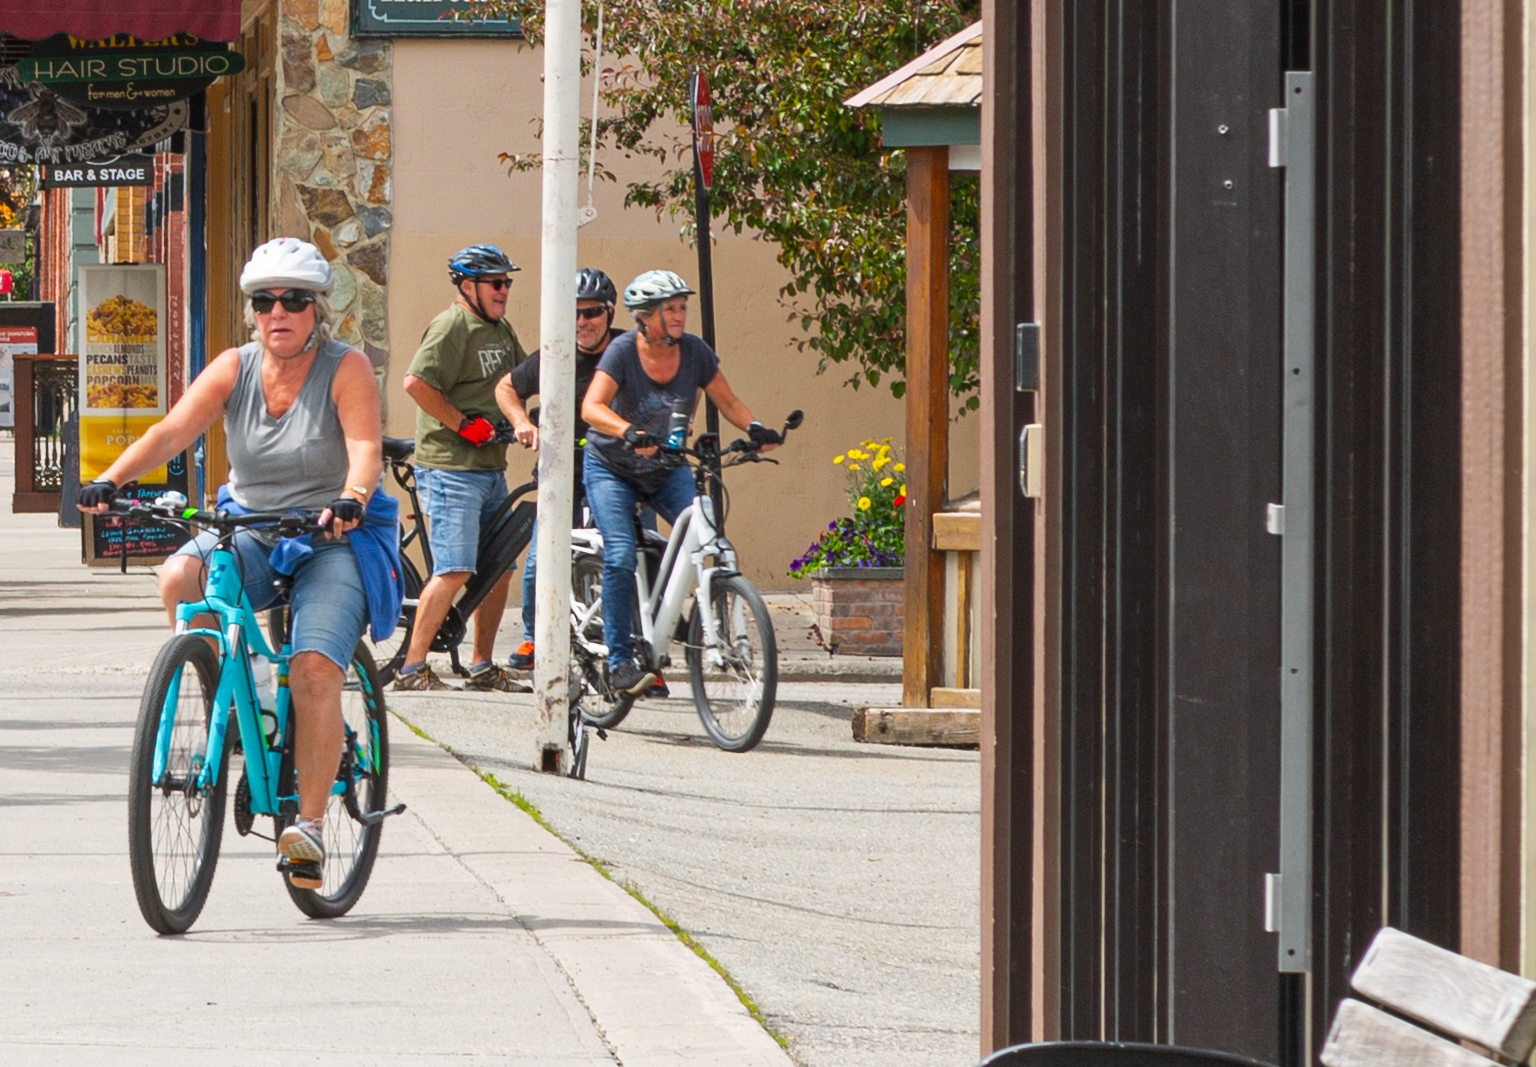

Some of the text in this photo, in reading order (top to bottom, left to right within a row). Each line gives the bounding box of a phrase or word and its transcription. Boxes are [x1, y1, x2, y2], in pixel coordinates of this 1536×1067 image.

[34, 55, 230, 80] HAIR STUDIO
[88, 83, 106, 101] for
[106, 90, 125, 100] men
[143, 88, 176, 98] women
[53, 168, 145, 182] BAR & STAGE
[113, 344, 145, 354] ALMONDS
[86, 354, 157, 365] PECANS TASTE
[127, 364, 158, 375] PEANUTS
[86, 375, 140, 386] POPCORN
